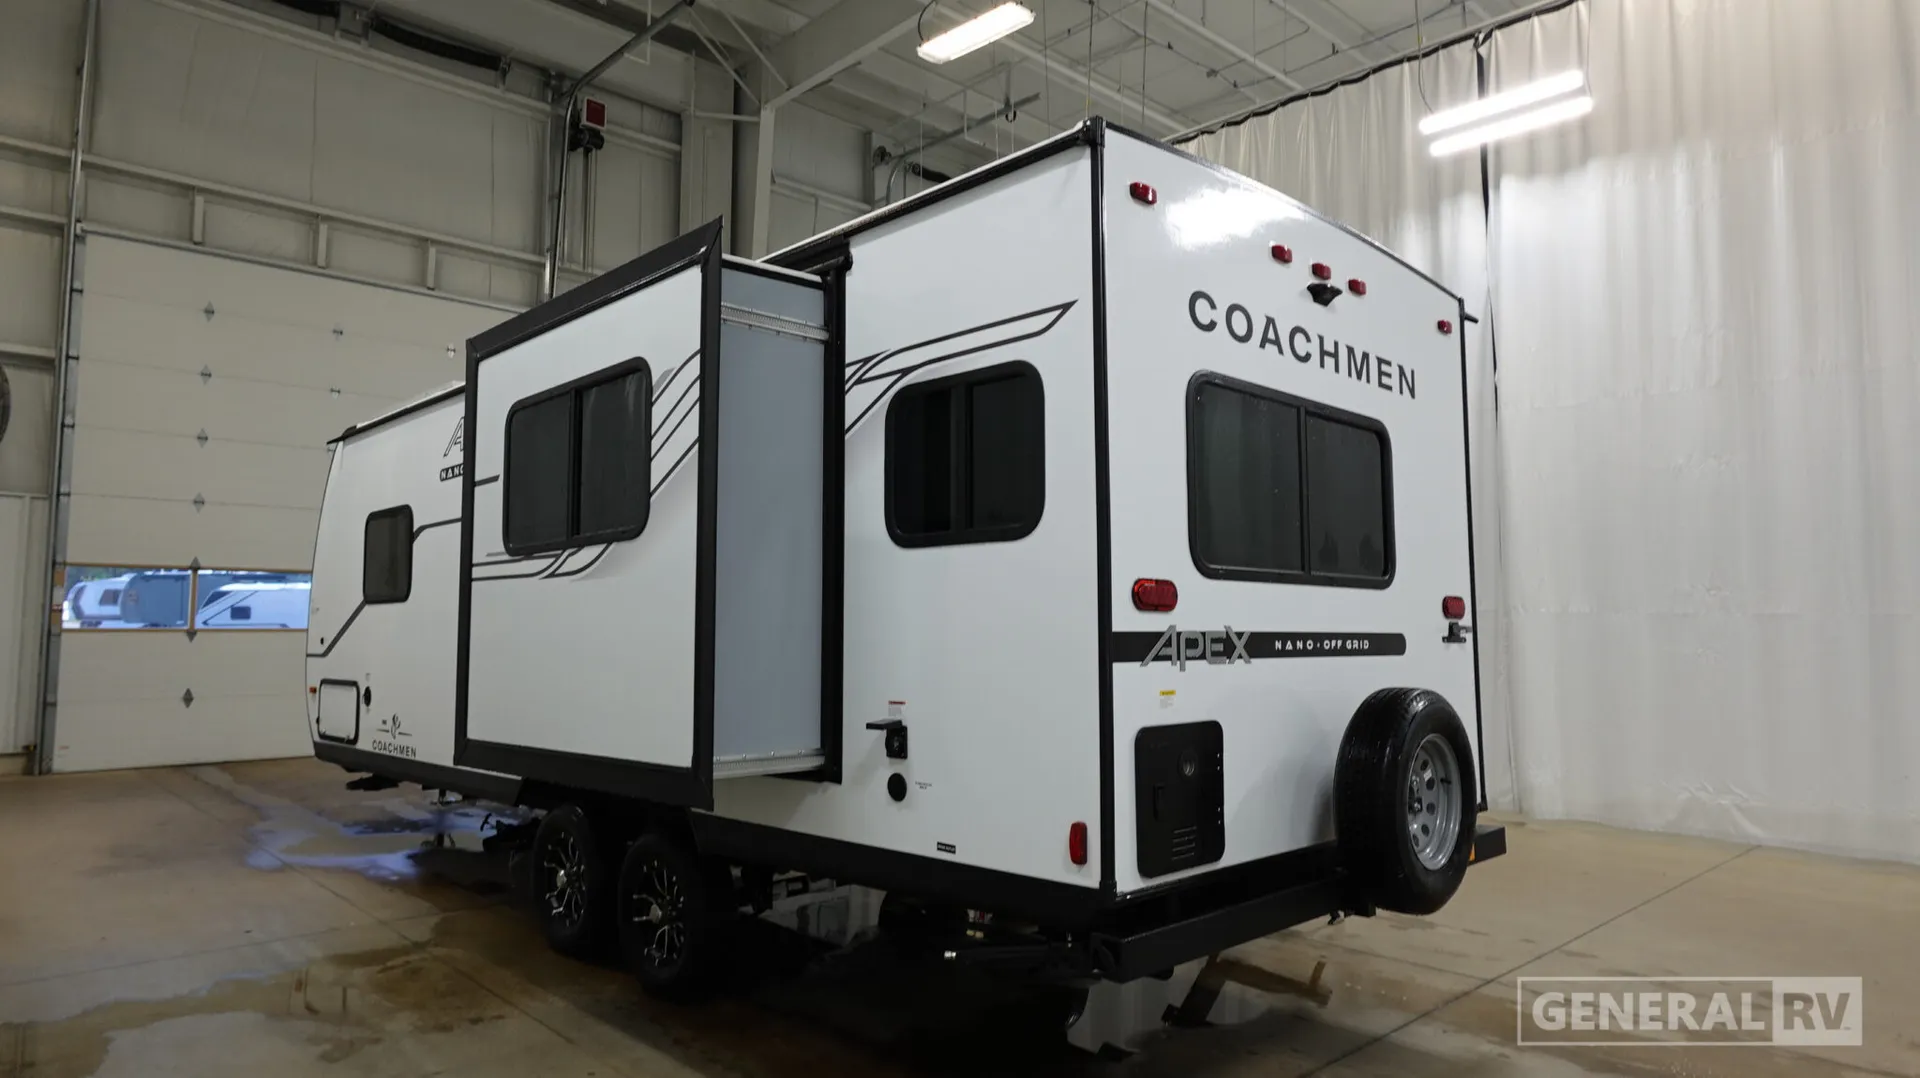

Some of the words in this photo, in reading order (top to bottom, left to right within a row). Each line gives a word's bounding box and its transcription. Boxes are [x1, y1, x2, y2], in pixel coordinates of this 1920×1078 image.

[1188, 290, 1416, 400] COACHMEN
[1140, 624, 1252, 672] APEX
[1275, 639, 1314, 650] NANO
[1323, 639, 1342, 650] OFF
[1345, 639, 1370, 650] GRID
[372, 739, 417, 759] COACHMEN
